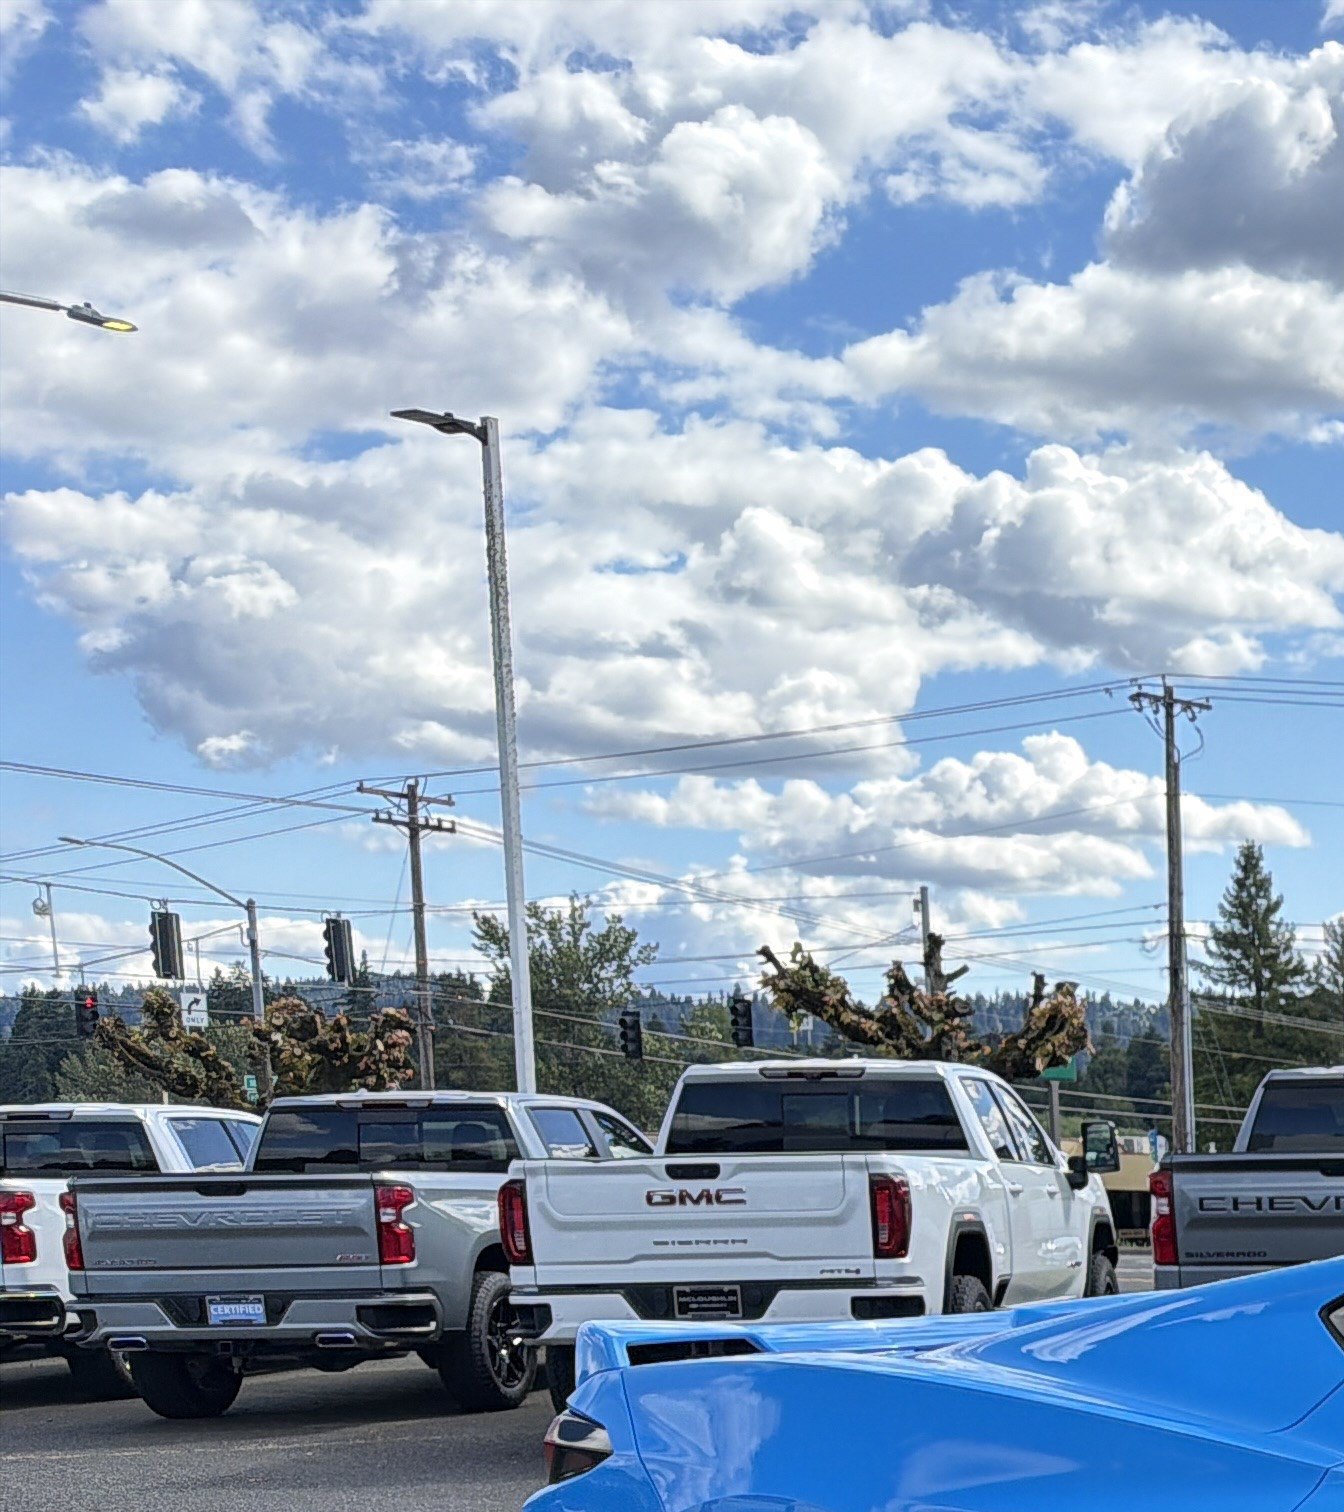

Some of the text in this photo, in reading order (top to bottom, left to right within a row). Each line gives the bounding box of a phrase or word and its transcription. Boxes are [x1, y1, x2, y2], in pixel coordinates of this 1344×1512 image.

[185, 1016, 205, 1024] ONLY
[645, 1187, 747, 1207] GMC
[95, 1210, 352, 1229] CHEVROLET
[1184, 1250, 1268, 1259] SILVERADO
[210, 1303, 264, 1315] CERTIFIED
